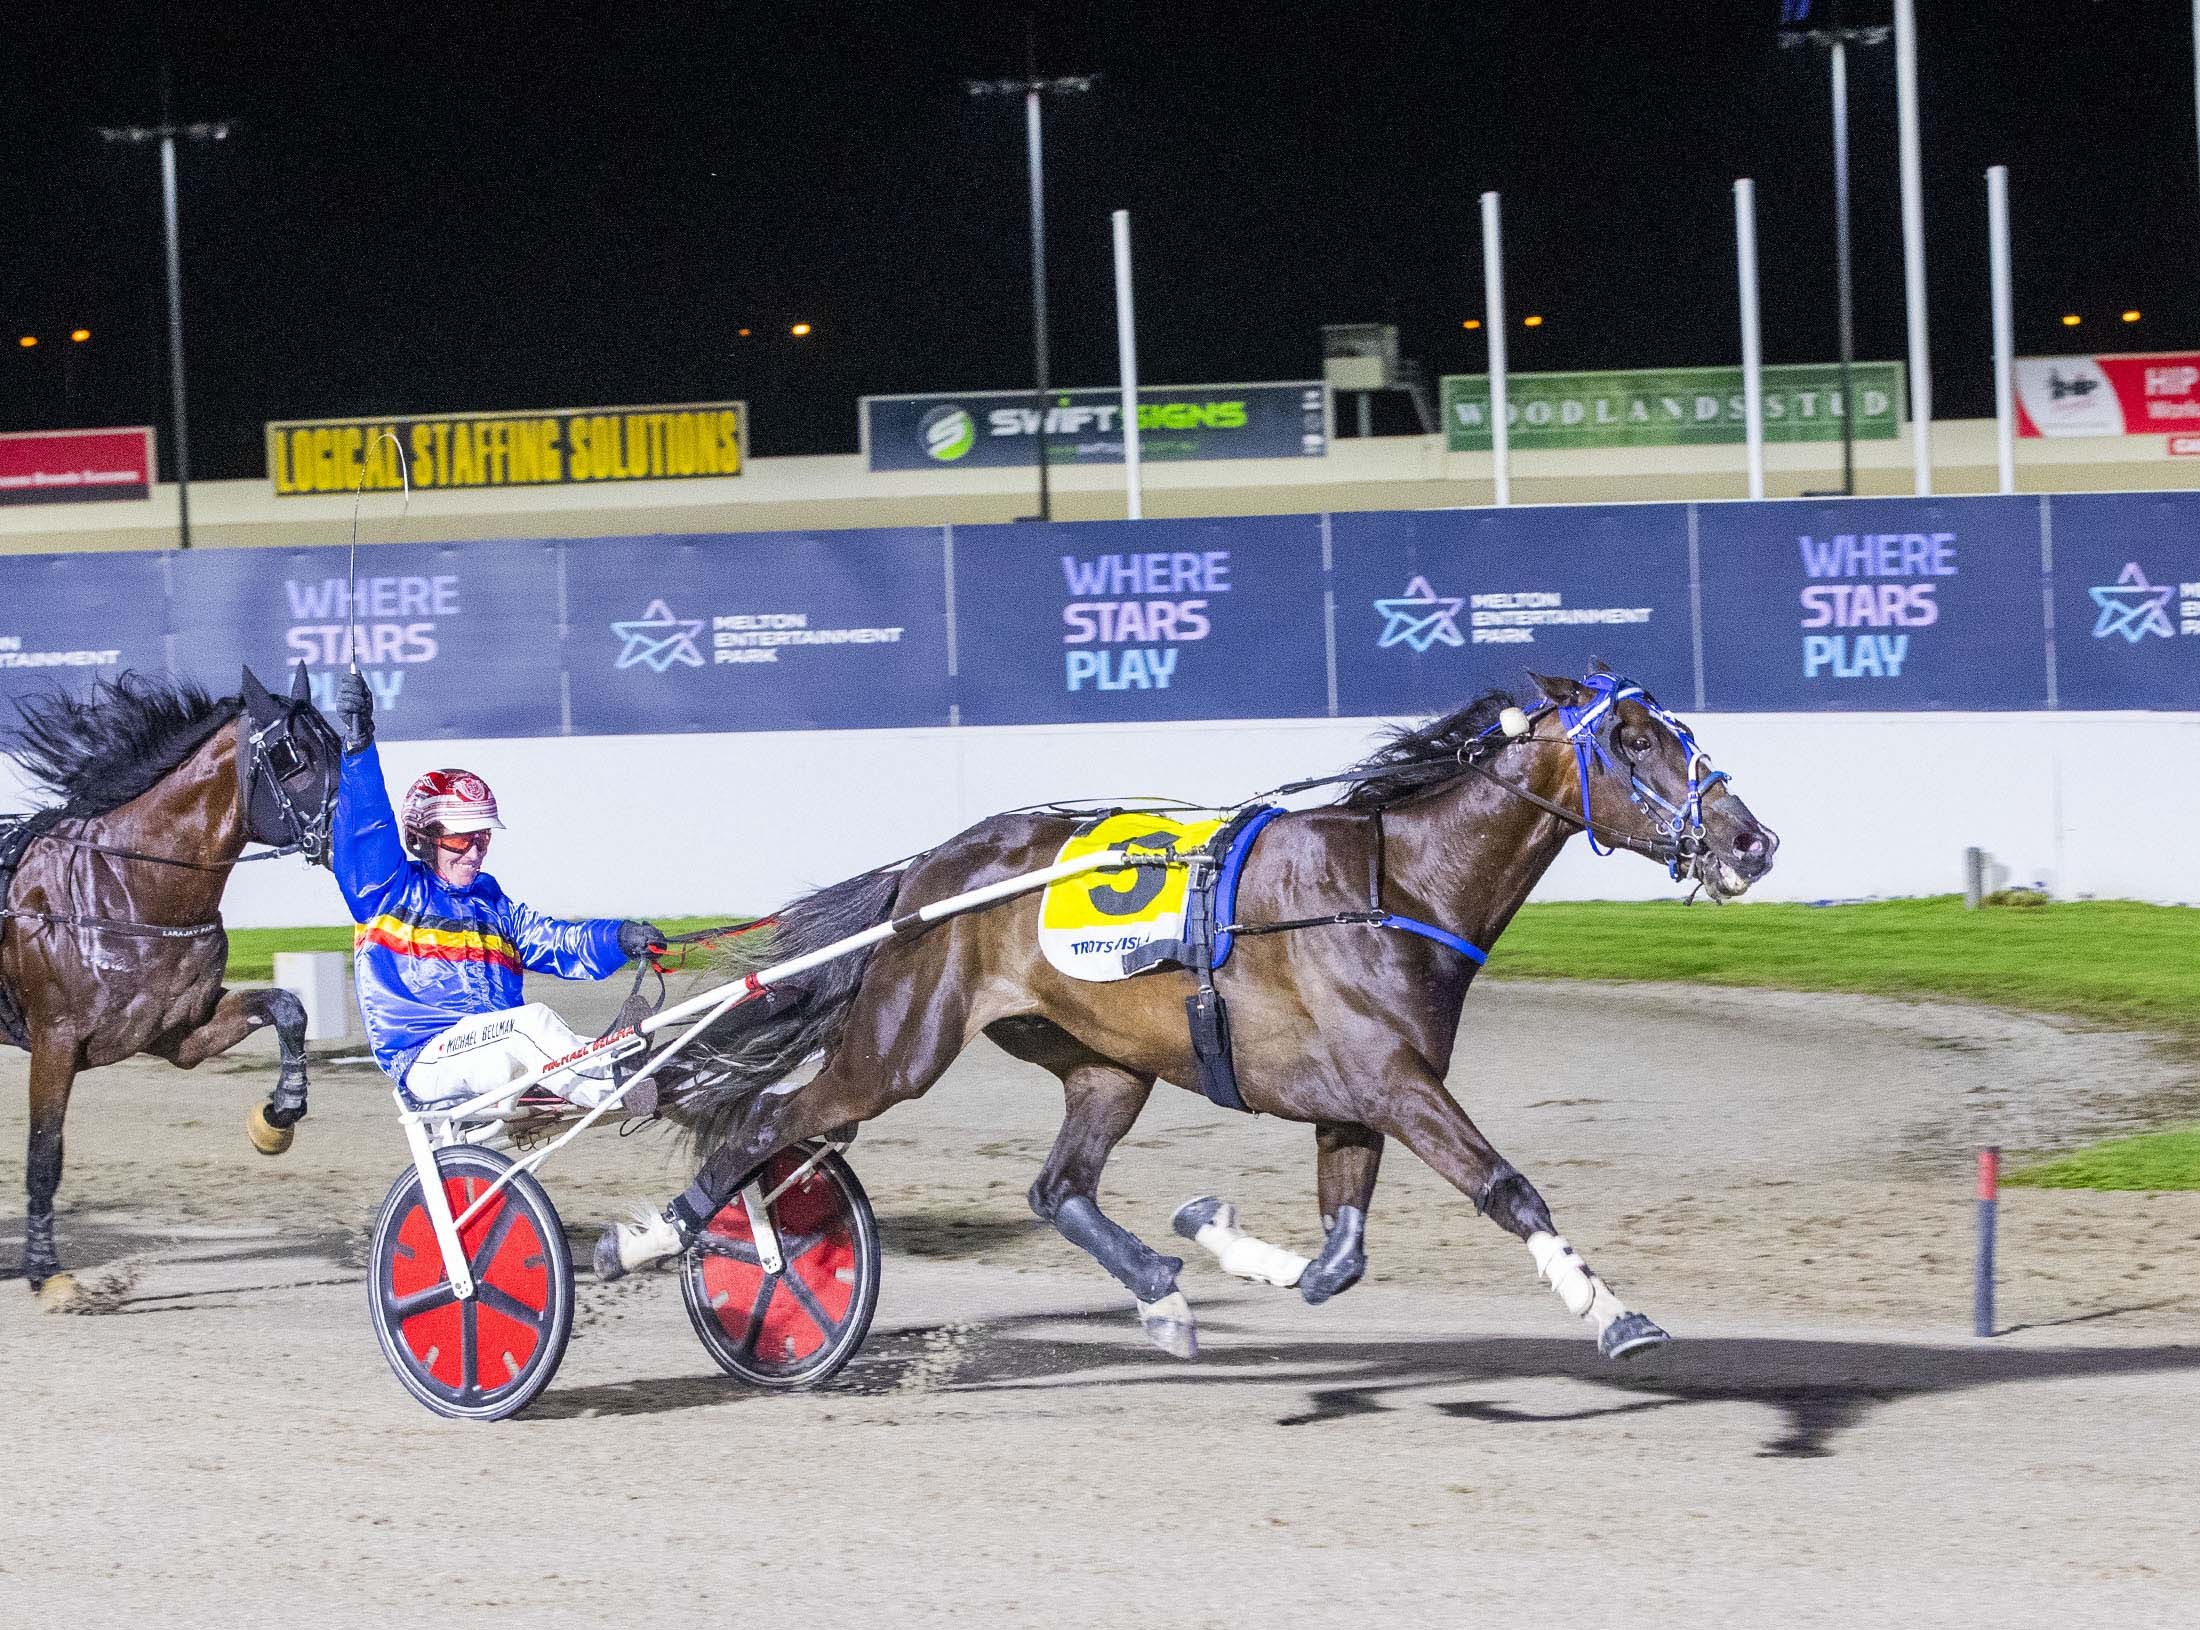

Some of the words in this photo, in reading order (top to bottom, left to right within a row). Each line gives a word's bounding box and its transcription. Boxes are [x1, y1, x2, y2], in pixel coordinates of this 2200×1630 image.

[2144, 367, 2198, 395] HIP
[276, 427, 404, 493] LOGICAL
[411, 418, 562, 487] STAFFING
[569, 410, 739, 479] SOLUTIONS
[1062, 551, 1232, 595] WHERE
[1799, 533, 1958, 577] WHERE
[285, 575, 461, 618] WHERE
[1470, 592, 1562, 608] MELTON
[1471, 608, 1654, 626] ENTERTAINMENT
[1800, 583, 1938, 628] STARS
[713, 614, 807, 630] MELTON
[714, 627, 905, 647] ENTERTAINMENT
[1062, 600, 1211, 643] STARS
[1472, 628, 1535, 643] PARK
[287, 622, 438, 666] STARS
[714, 649, 778, 664] PARK
[1803, 635, 1909, 678] PLAY
[1066, 648, 1179, 692] PLAY
[447, 1031, 477, 1053] MICHAEL
[482, 1018, 515, 1042] BELLMAN
[542, 1047, 589, 1073] MICHAEL
[592, 1025, 635, 1052] BELLMA
